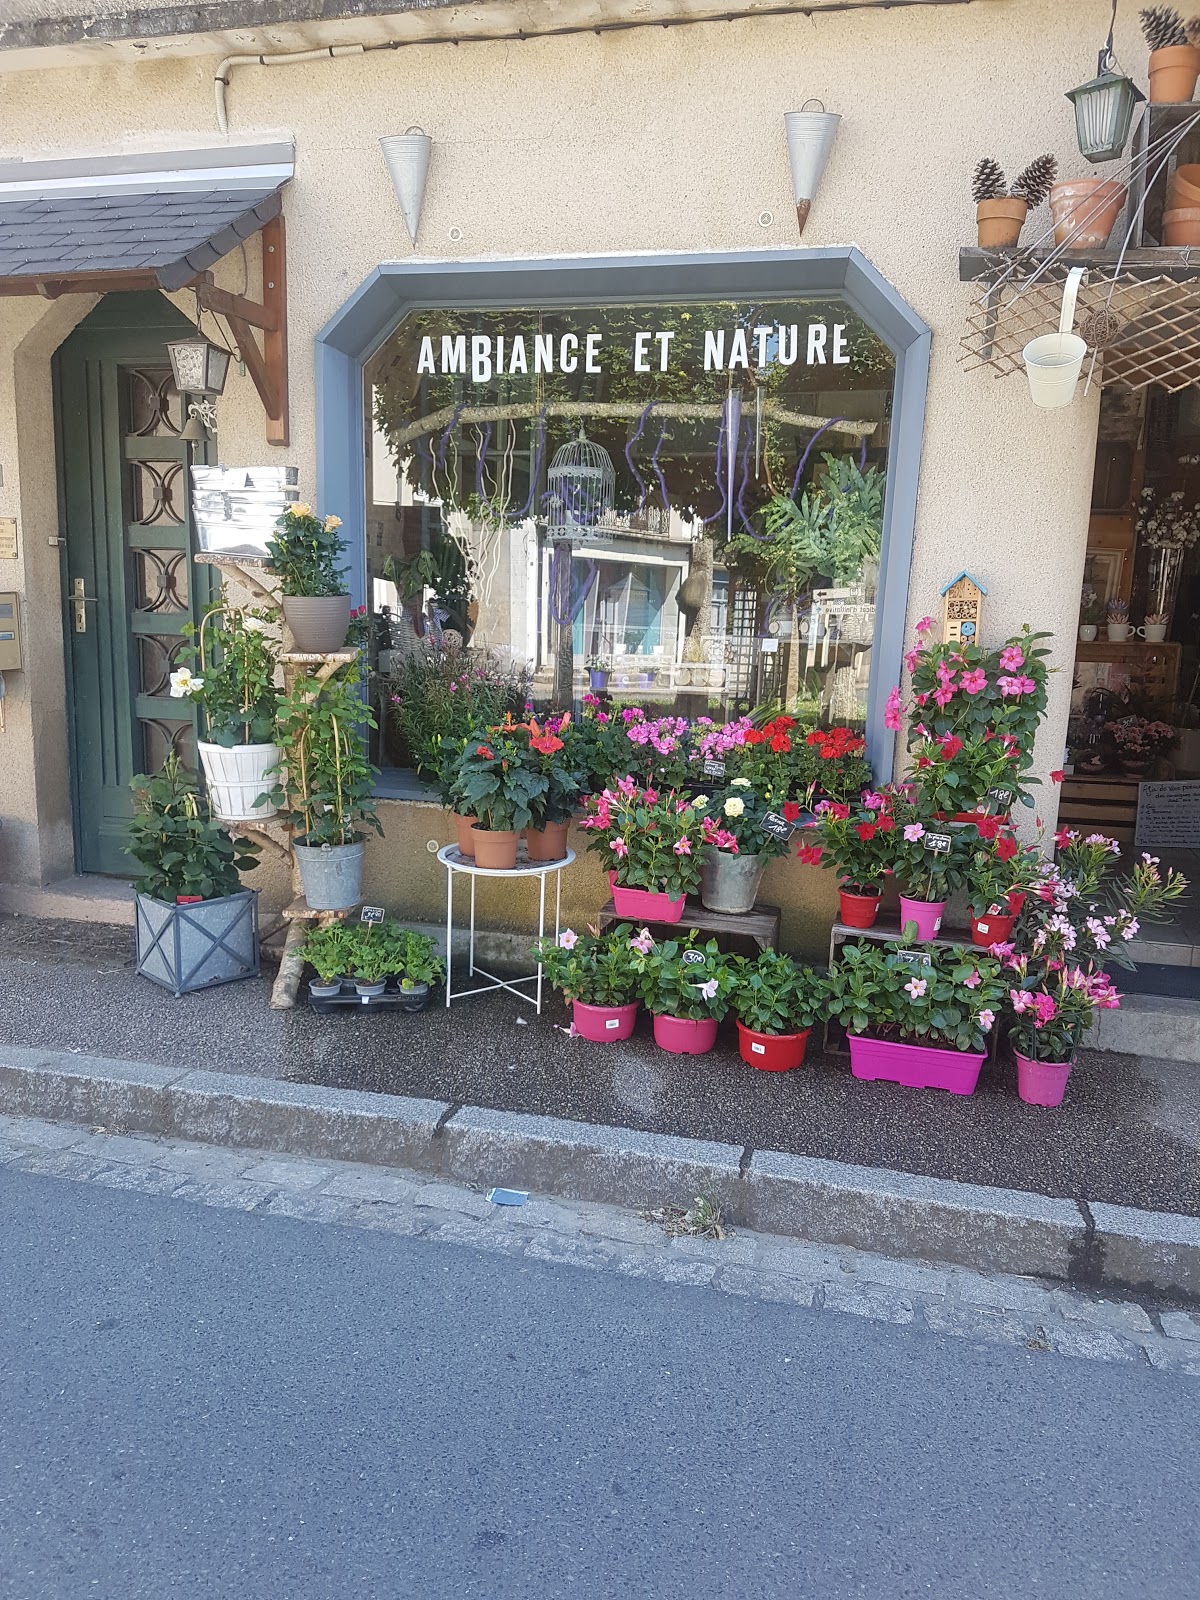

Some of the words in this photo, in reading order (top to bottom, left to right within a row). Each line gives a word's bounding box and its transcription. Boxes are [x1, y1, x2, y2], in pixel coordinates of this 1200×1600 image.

[416, 333, 602, 382] AMBIANCE
[634, 331, 675, 371] ET
[704, 324, 850, 370] NATURE
